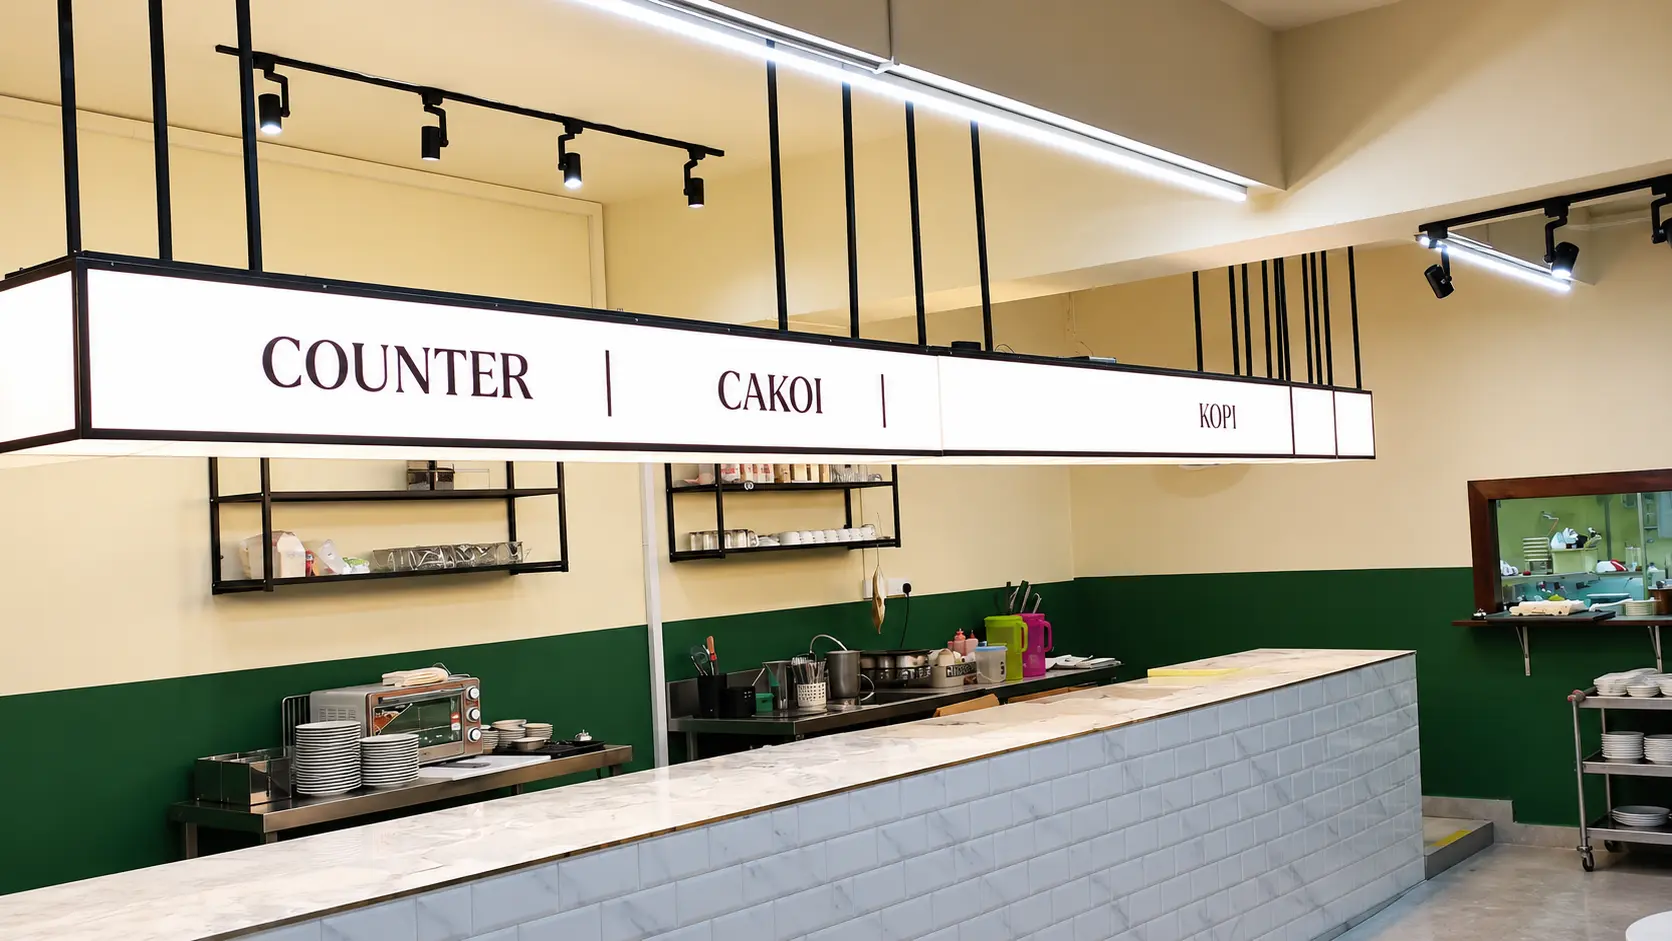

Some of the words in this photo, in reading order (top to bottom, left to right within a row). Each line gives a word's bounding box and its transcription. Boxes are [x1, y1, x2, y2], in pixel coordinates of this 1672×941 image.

[262, 336, 534, 400] COUNTER
[717, 370, 823, 414] CAKOI
[1199, 402, 1237, 430] KOPI
